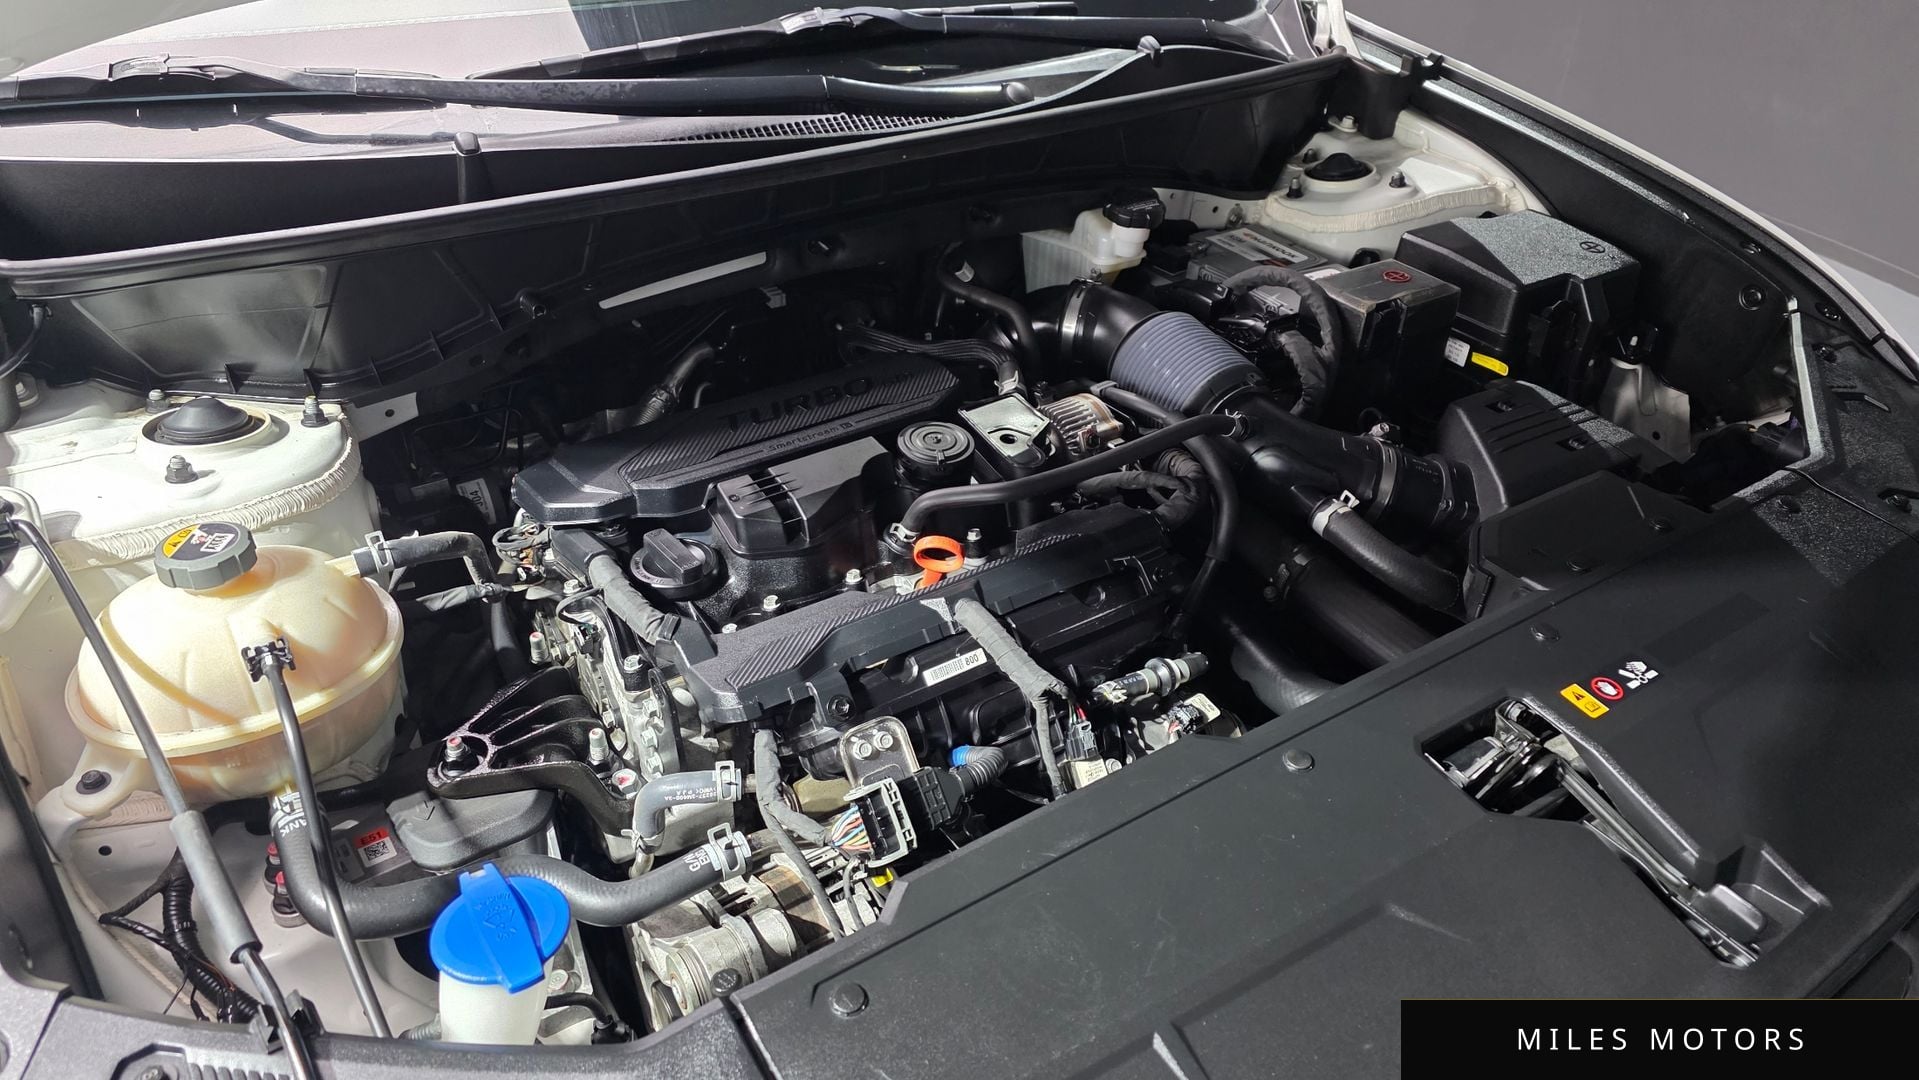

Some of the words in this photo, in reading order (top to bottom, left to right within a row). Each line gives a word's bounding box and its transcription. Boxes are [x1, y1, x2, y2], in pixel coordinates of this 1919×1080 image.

[719, 376, 873, 432] TURBO
[965, 653, 979, 666] 800
[280, 818, 308, 838] ANK
